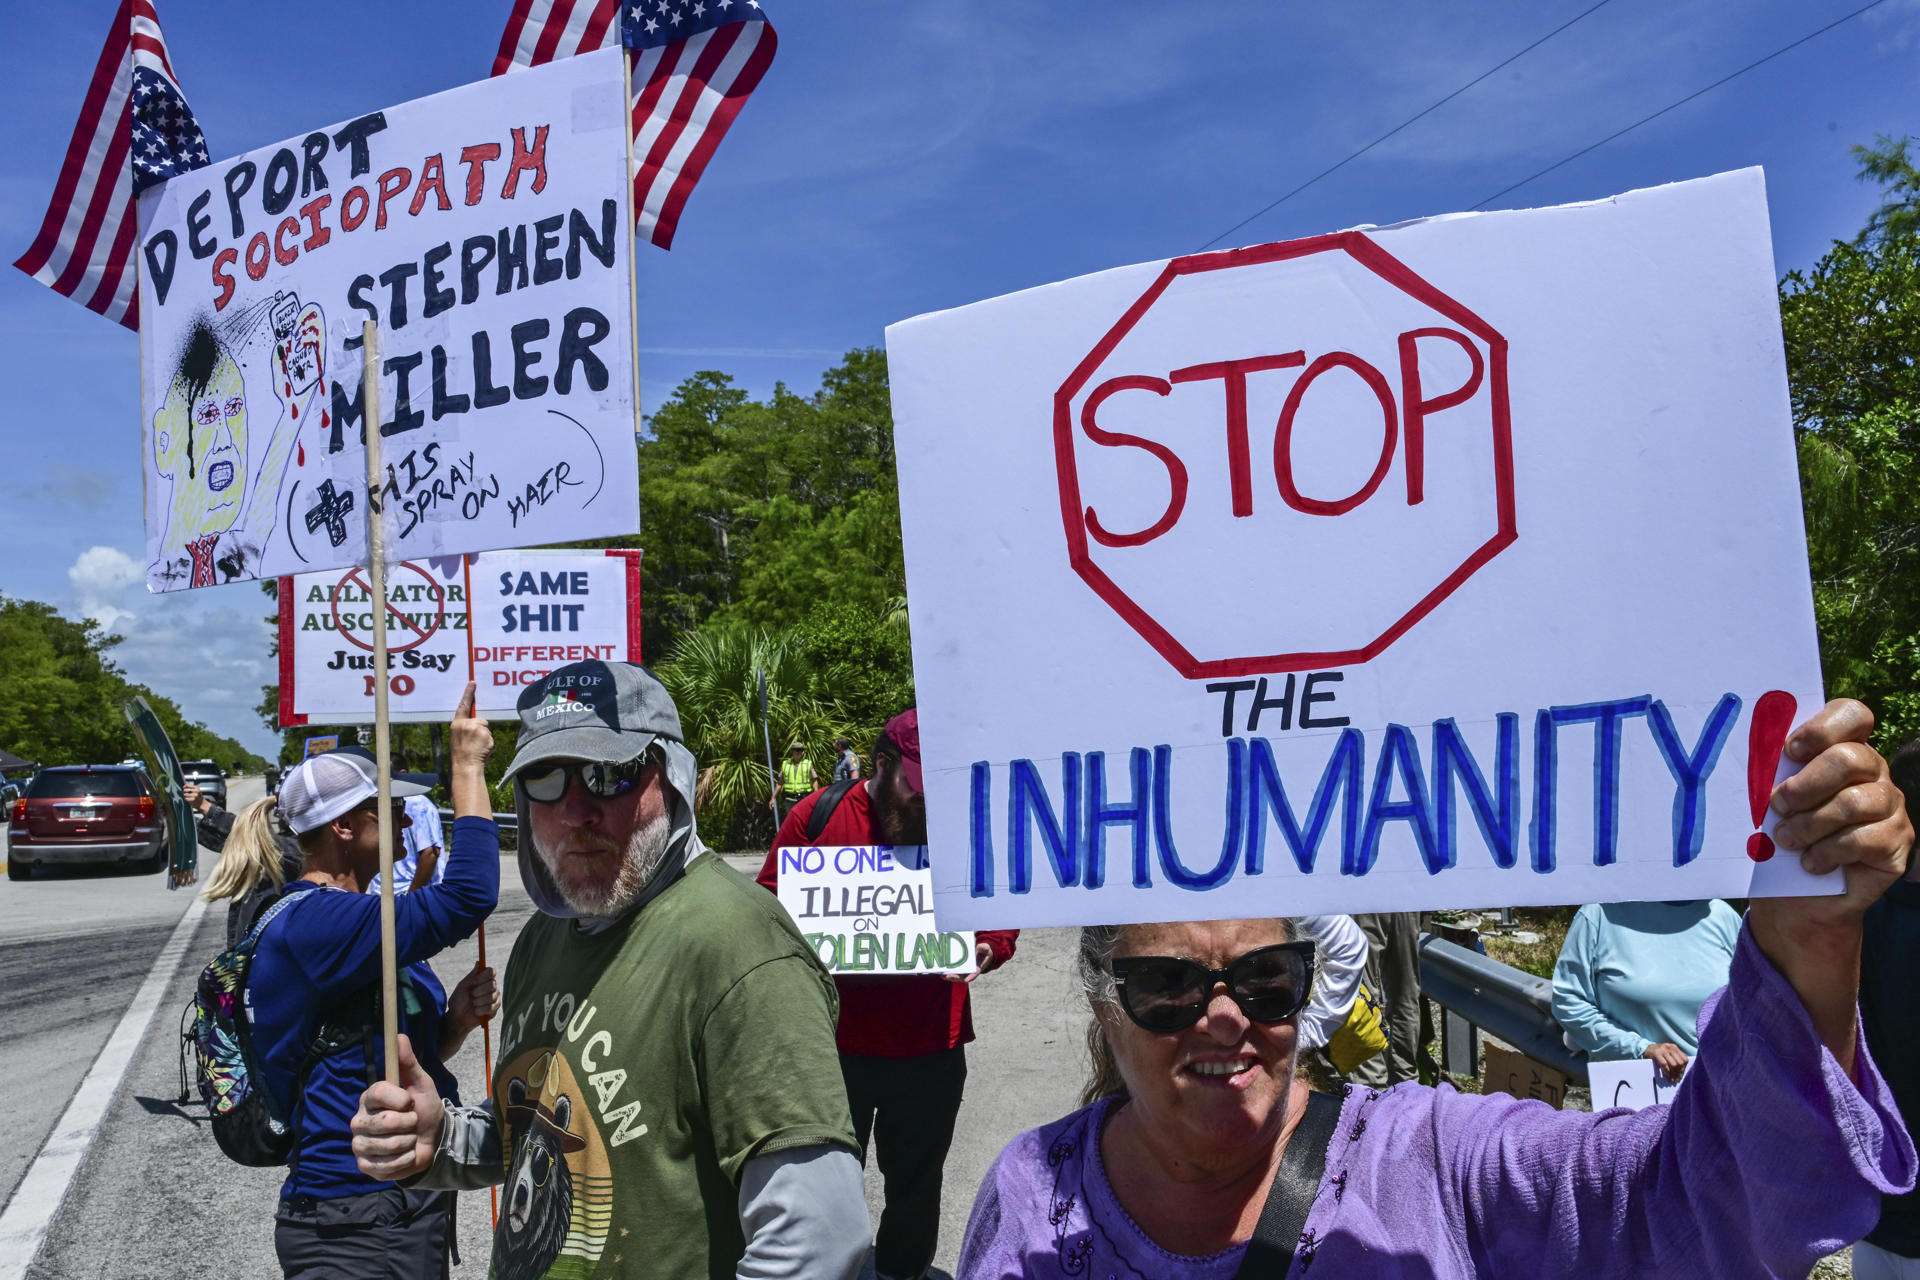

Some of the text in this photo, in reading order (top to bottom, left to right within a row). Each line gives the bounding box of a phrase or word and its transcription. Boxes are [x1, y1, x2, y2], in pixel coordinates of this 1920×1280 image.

[144, 112, 388, 306] DEPORT
[211, 124, 550, 312] SOCIOPATH
[343, 199, 617, 351] STEPHEN
[330, 307, 609, 454] MILLER
[1081, 327, 1484, 548] STOP
[400, 451, 474, 539] SPRAY
[462, 473, 499, 519] ON
[306, 585, 465, 602] ALLIATOR
[500, 571, 589, 596] SAME
[502, 604, 584, 633] SHIT
[402, 650, 456, 672] Say
[474, 645, 616, 662] DIFFERENT
[493, 670, 553, 686] DICT
[579, 675, 602, 687] OF
[536, 701, 596, 721] MEXICO
[1206, 672, 1350, 737] THE
[970, 690, 1797, 898] INHUMANITY!
[781, 847, 825, 875] NO
[834, 845, 894, 875] ONE
[799, 884, 934, 918] ILLEGAL
[853, 917, 879, 931] ON
[804, 931, 969, 971] TOLEN LAND
[541, 991, 597, 1043] YOU
[581, 1030, 649, 1148] CAN
